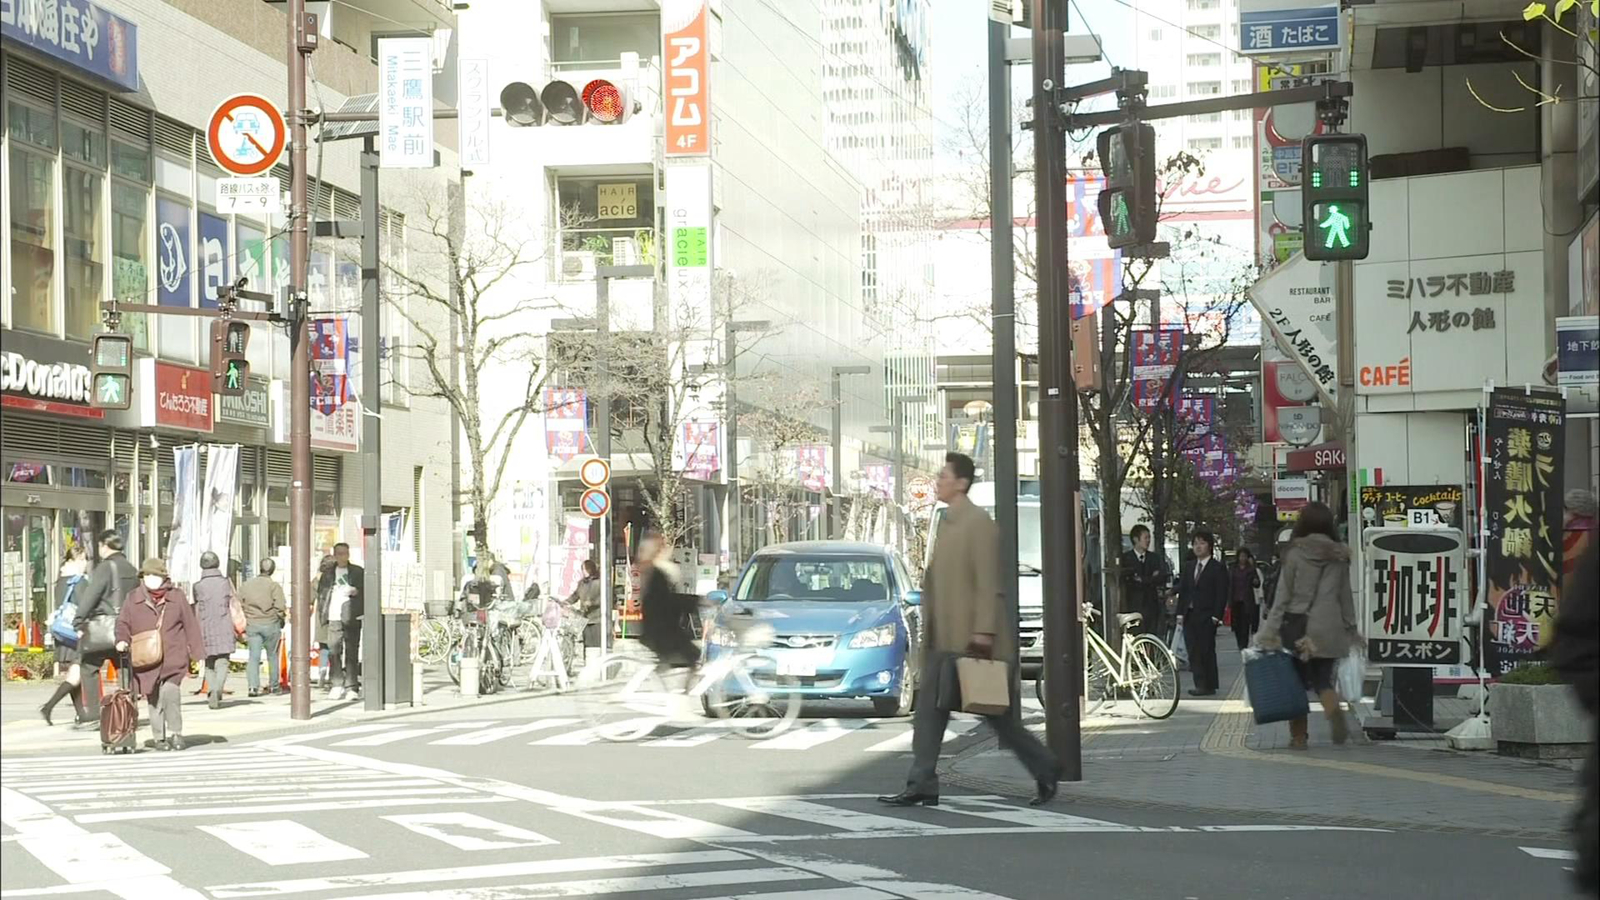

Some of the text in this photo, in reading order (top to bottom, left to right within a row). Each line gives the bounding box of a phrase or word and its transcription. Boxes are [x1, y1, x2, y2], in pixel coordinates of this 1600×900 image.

[1250, 25, 1329, 47] 酒 たばこ
[670, 37, 701, 126] アコム
[387, 55, 398, 151] Mitakaeki Mae
[403, 51, 424, 155] 三鷹駅前
[676, 134, 697, 147] 4F
[220, 183, 275, 194] 路線バスを除く
[600, 187, 634, 195] HAIR
[697, 227, 706, 265] HAIR
[1289, 287, 1330, 295] RESTAURANT
[1387, 270, 1515, 299] ミハラ不動産
[1309, 313, 1331, 322] CAFÉ
[1407, 307, 1496, 334] 人形の館
[1284, 329, 1335, 384] 人形の館
[1360, 357, 1410, 386] CAFÉ
[222, 390, 267, 413] MIKOSHI
[1362, 492, 1407, 502] ダッチ コーヒー
[1413, 487, 1462, 506] Cocktails
[1413, 512, 1429, 523] B1
[1373, 555, 1456, 638] 珈琲
[1379, 641, 1452, 659] リスボン
